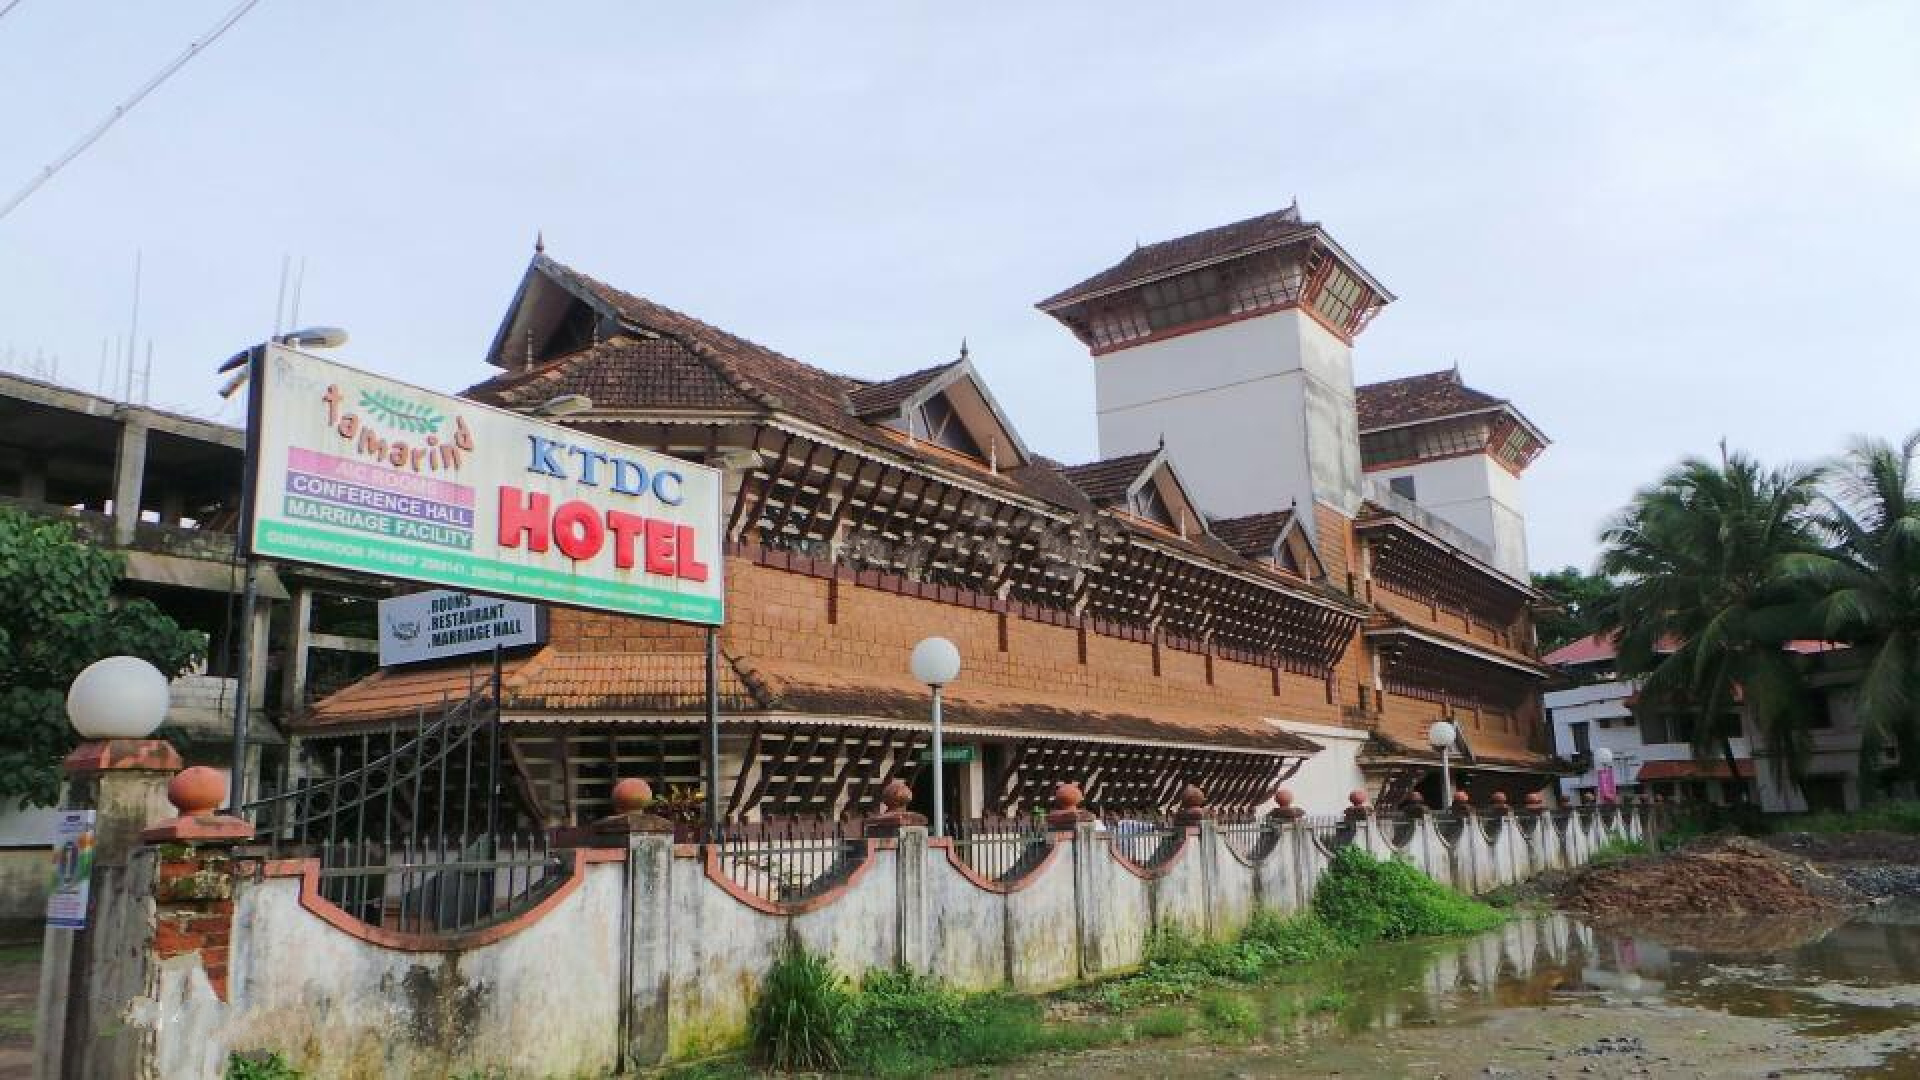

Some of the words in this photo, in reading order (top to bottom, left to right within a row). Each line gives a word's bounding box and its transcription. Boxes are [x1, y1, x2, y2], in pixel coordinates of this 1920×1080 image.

[322, 384, 474, 472] tamarind
[527, 434, 684, 507] KTDC
[288, 499, 391, 532] MARRIAGE
[395, 520, 472, 546] FACILITY
[293, 475, 421, 515] CONFERENCE
[425, 503, 469, 526] HALL
[497, 485, 709, 583] HOTEL
[431, 603, 505, 631] RESTAURANT
[431, 623, 491, 648] MARRIAGE
[493, 619, 522, 638] HALL
